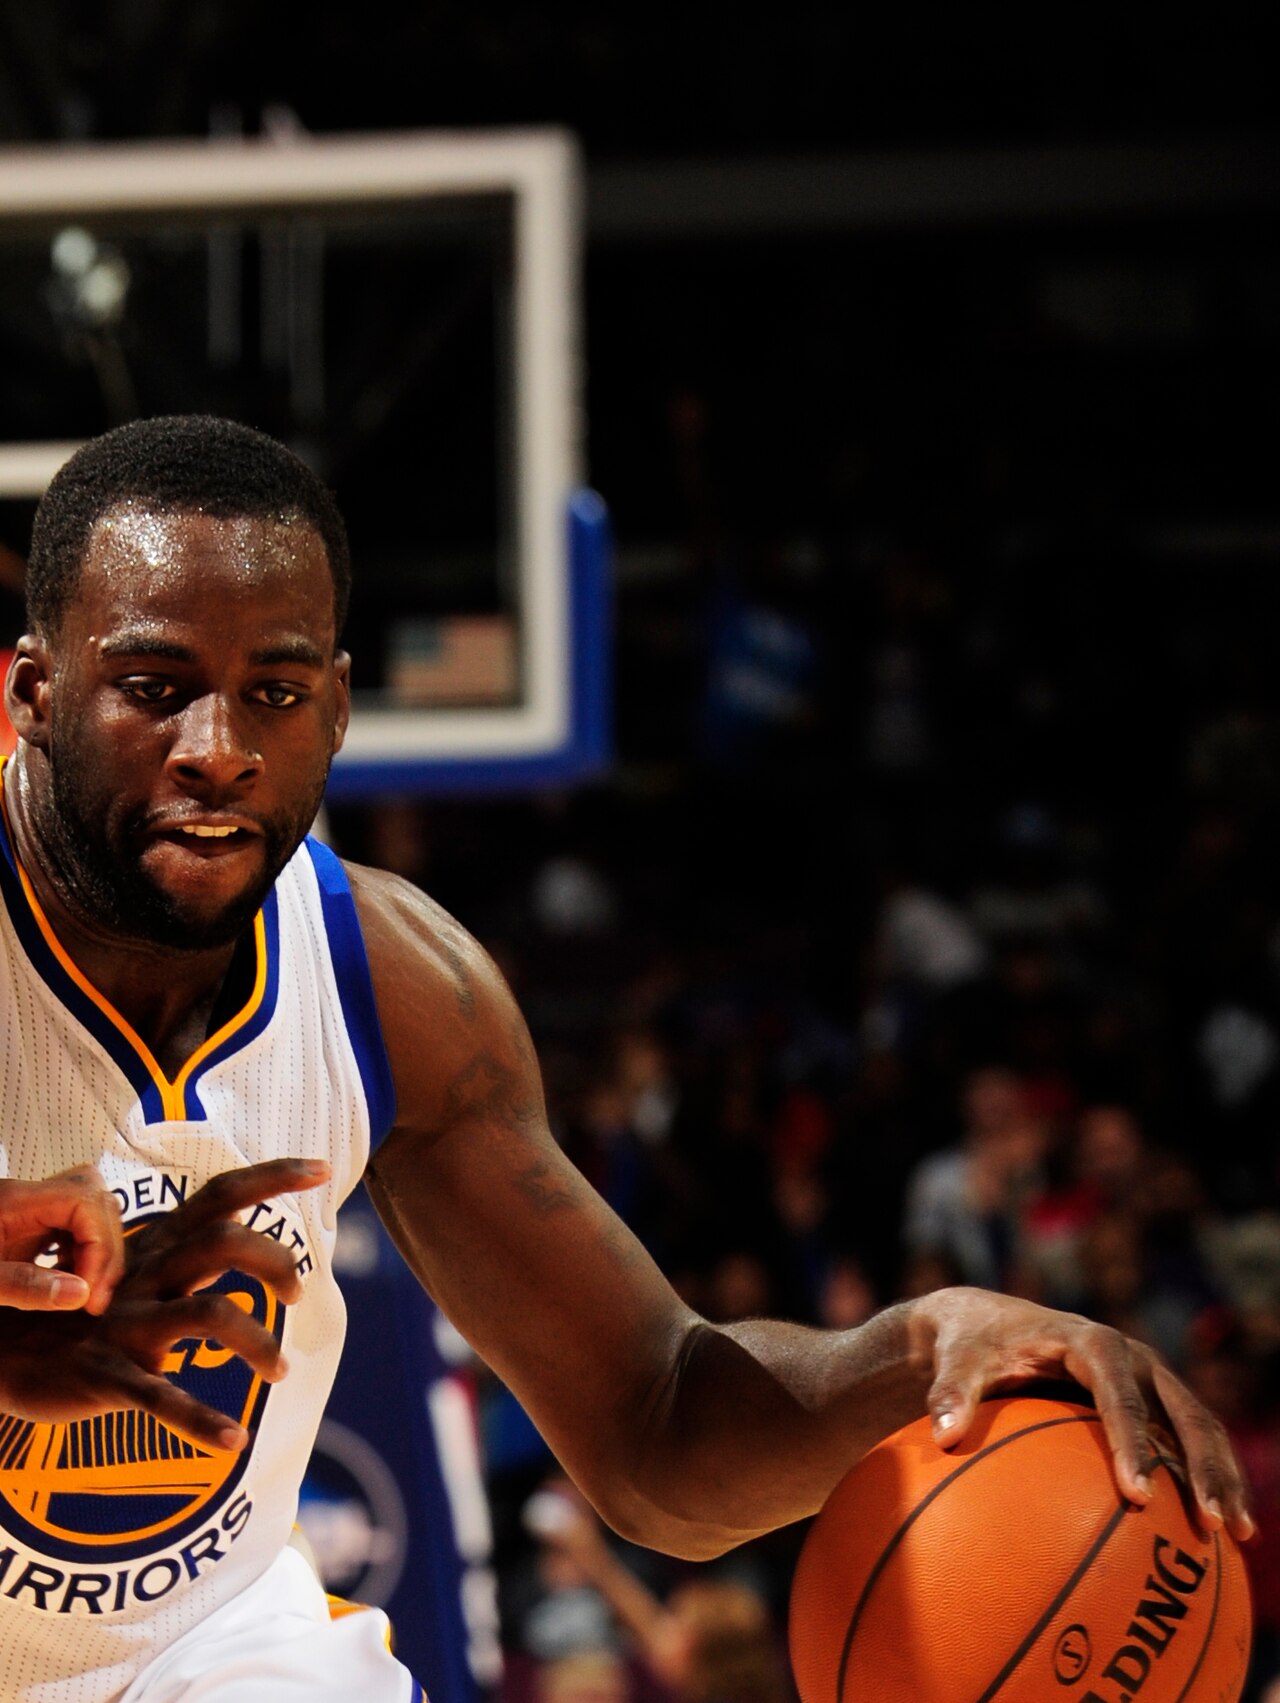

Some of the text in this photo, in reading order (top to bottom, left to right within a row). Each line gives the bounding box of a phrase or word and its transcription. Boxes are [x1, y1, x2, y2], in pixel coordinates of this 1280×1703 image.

[111, 1173, 314, 1277] DEN TATE
[1078, 1533, 1208, 1703] DING
